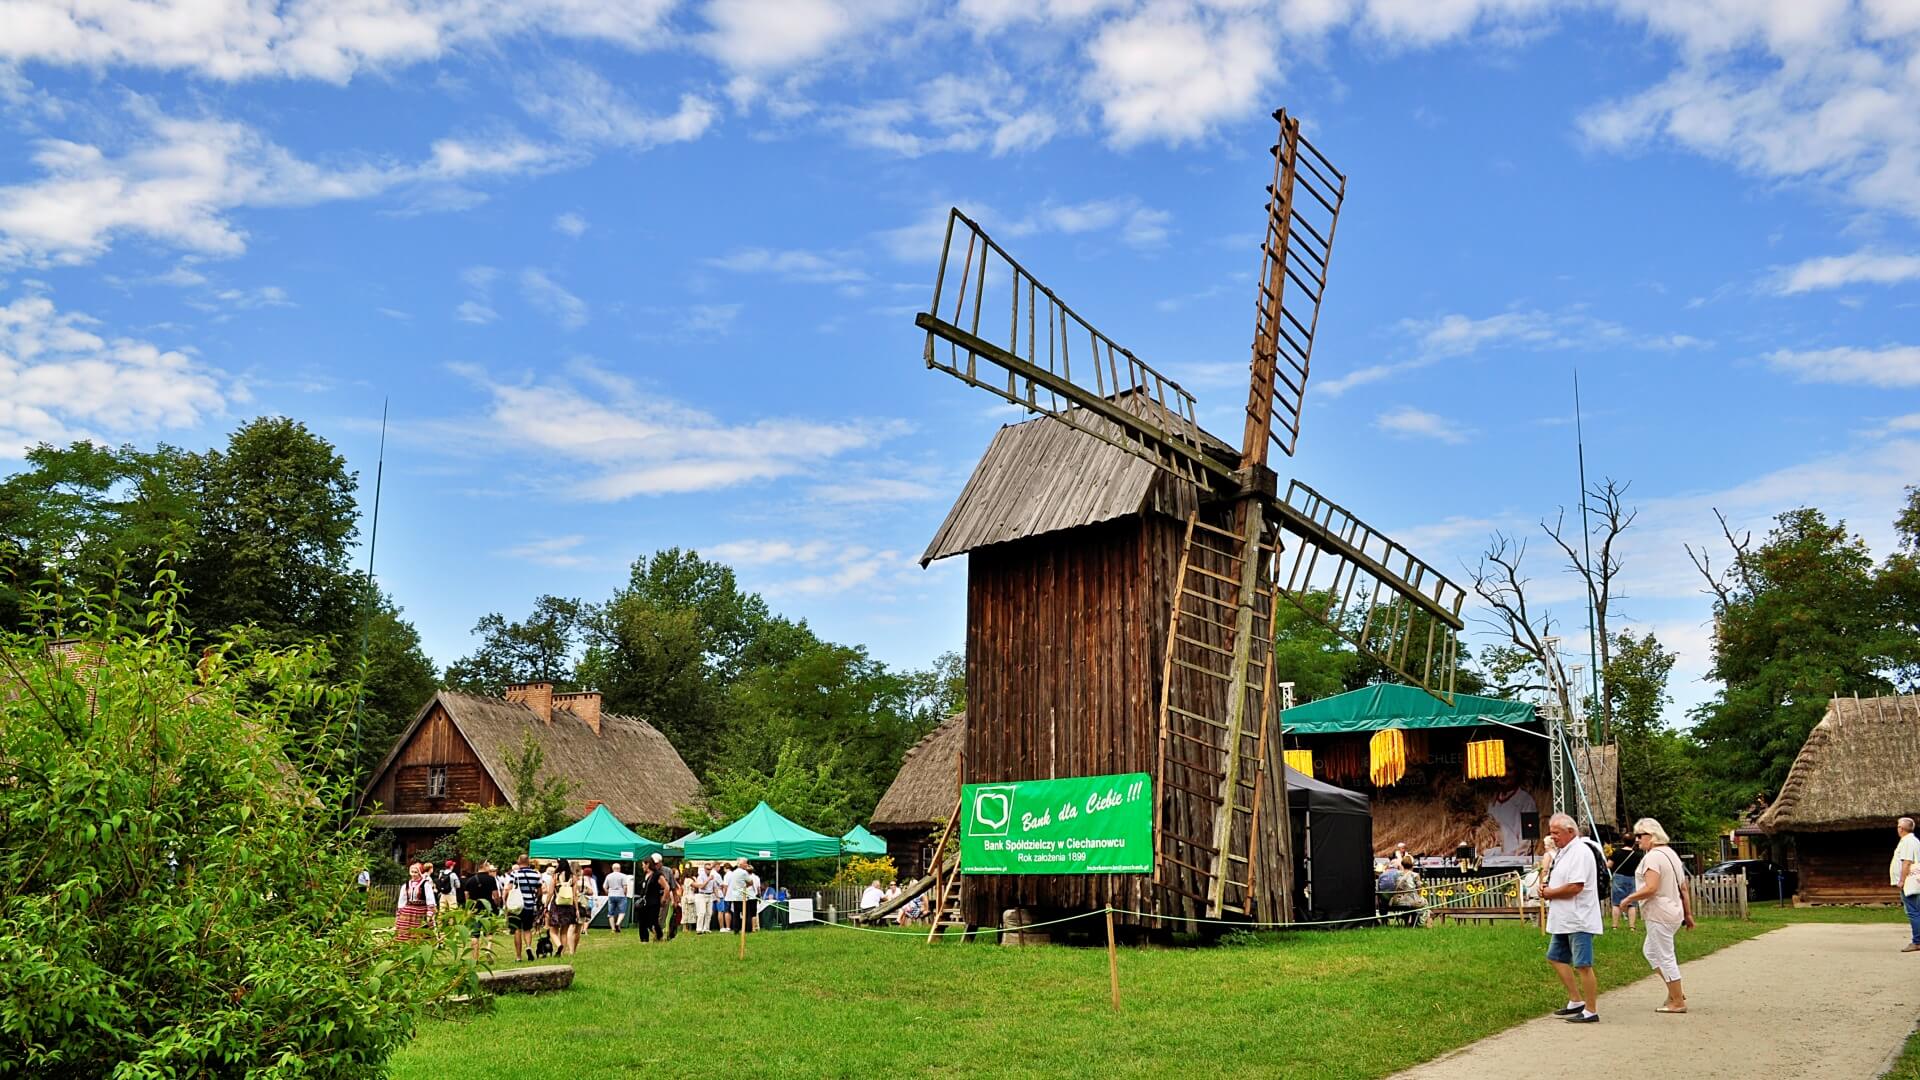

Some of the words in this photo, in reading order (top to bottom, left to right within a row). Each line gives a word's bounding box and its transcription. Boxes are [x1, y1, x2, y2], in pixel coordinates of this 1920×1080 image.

[1021, 808, 1051, 832] Bank
[1058, 802, 1078, 822] dla
[1085, 788, 1123, 814] Ciebie
[1126, 781, 1143, 803] !!!
[984, 839, 1004, 851] Bank
[1005, 838, 1055, 853] Spółdzielczy
[1057, 841, 1064, 849] w
[1066, 837, 1125, 849] Ciechanowcu
[1018, 853, 1032, 863] Rok
[1034, 852, 1066, 862] założenia
[1068, 852, 1086, 862] 1899
